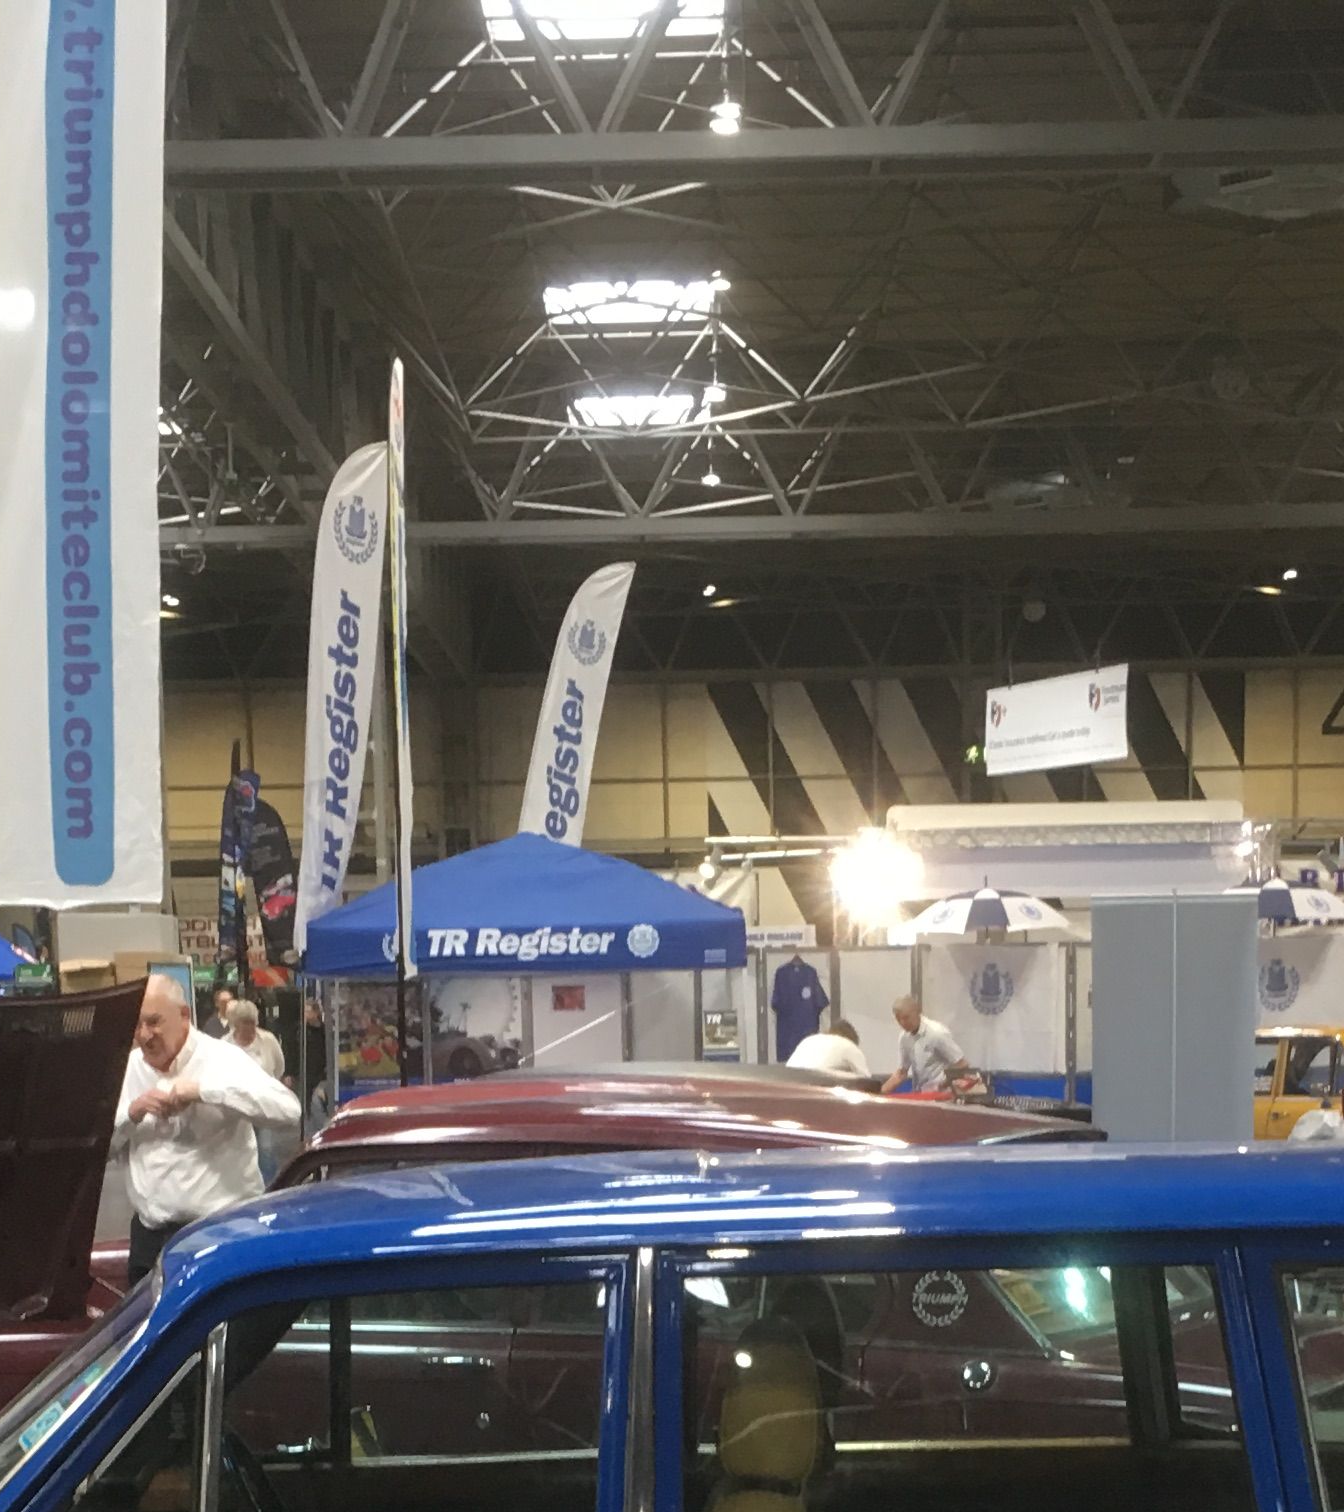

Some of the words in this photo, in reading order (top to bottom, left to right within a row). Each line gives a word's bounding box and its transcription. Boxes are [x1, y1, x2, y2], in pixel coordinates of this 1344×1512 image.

[53, 0, 103, 840] .triumphdolomiteclub.com
[325, 588, 361, 820] Register
[545, 678, 584, 839] egister
[427, 928, 470, 957] TR
[475, 926, 616, 961] Register
[912, 1291, 969, 1305] TRIUMPH
